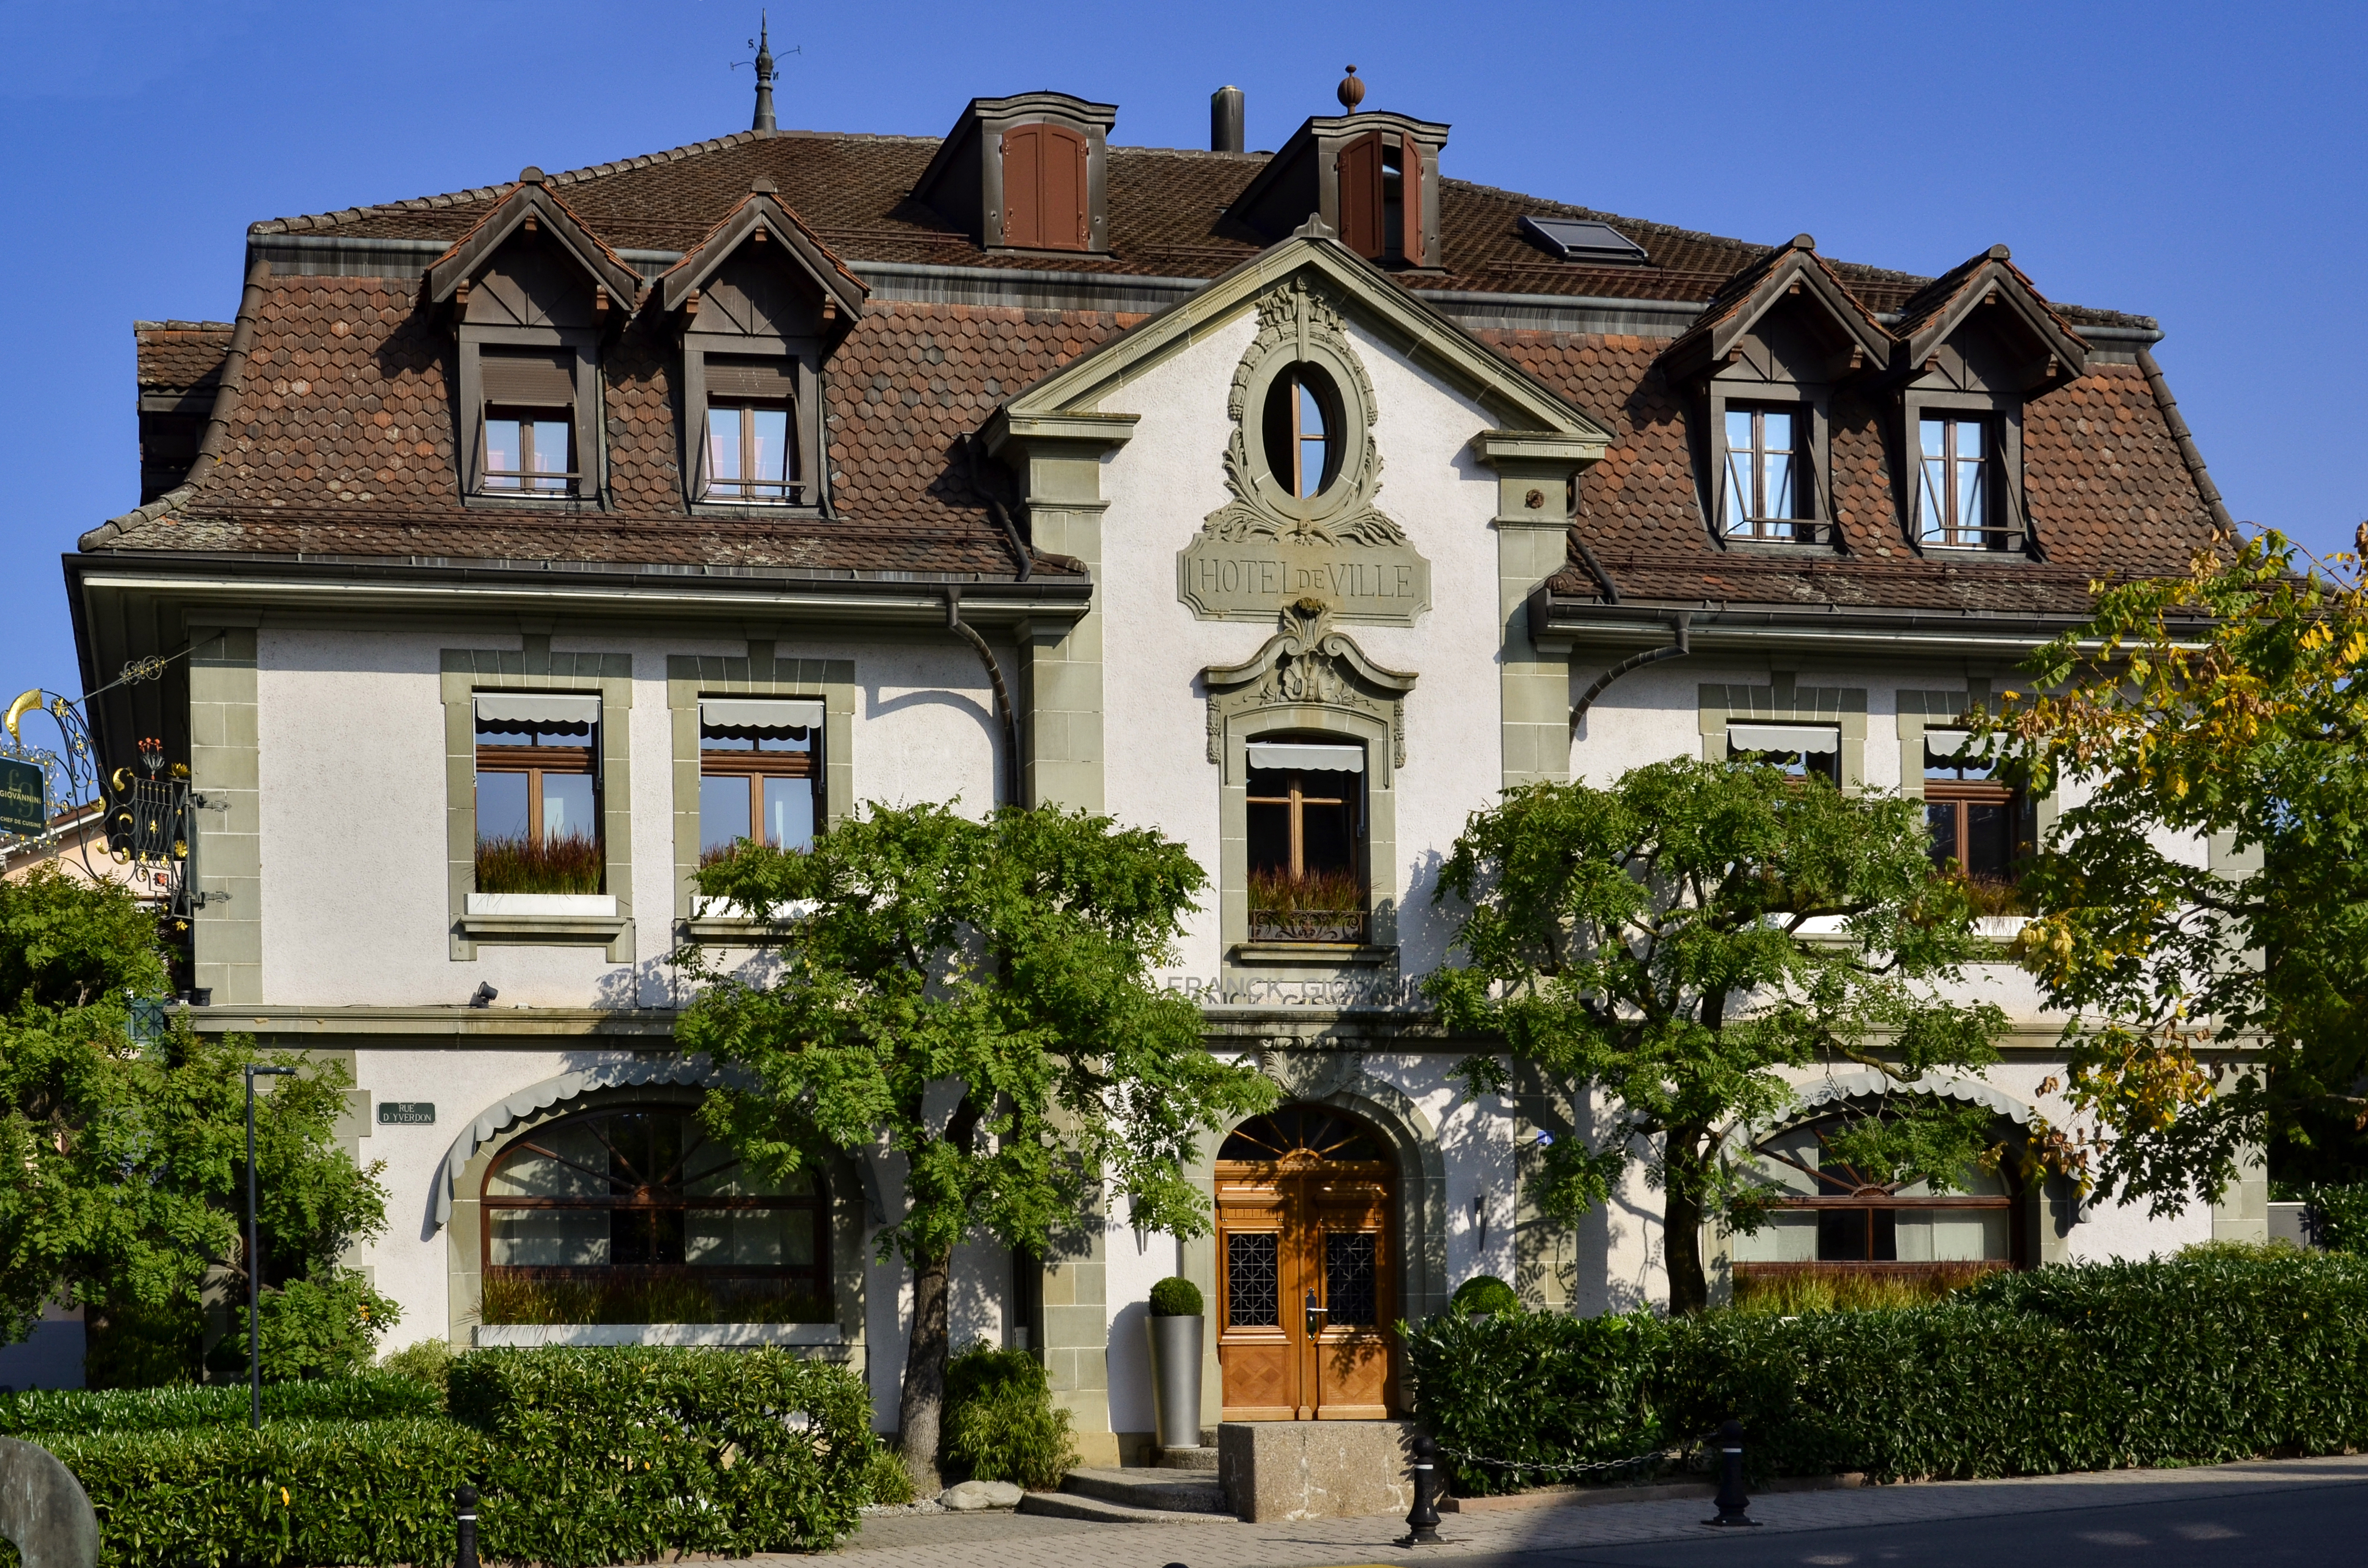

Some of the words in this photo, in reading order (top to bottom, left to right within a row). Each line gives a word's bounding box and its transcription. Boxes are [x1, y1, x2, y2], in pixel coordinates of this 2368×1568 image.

[1198, 558, 1300, 594] HOTEL
[1296, 569, 1325, 589] DE
[1323, 563, 1415, 598] VILLE
[0, 790, 41, 805] GIOVANNINI
[22, 820, 41, 829] CUISINE
[1167, 976, 1284, 998] FRANCK
[399, 1104, 415, 1113] RUE
[383, 1113, 432, 1122] D'YVERDON
